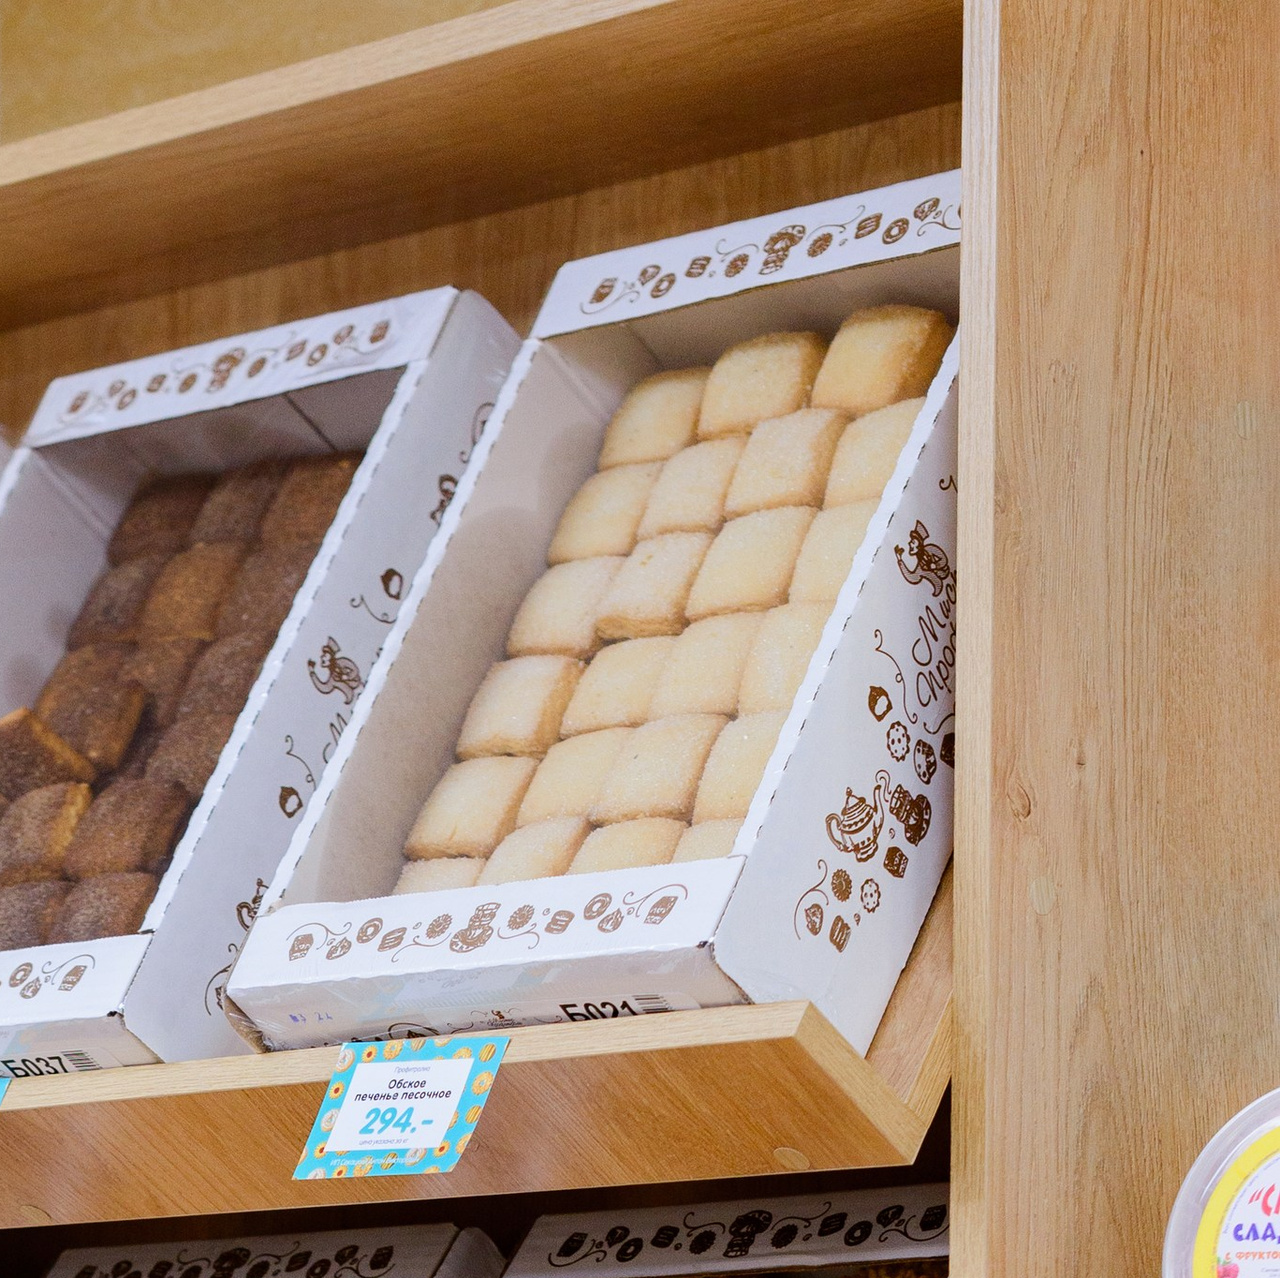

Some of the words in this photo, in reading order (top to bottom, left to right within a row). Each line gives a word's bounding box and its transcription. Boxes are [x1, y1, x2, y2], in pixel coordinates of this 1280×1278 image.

[387, 1079, 427, 1090] Обское
[354, 1092, 399, 1102] печенье
[400, 1089, 452, 1100] песочное
[1233, 1222, 1280, 1244] СЛА
